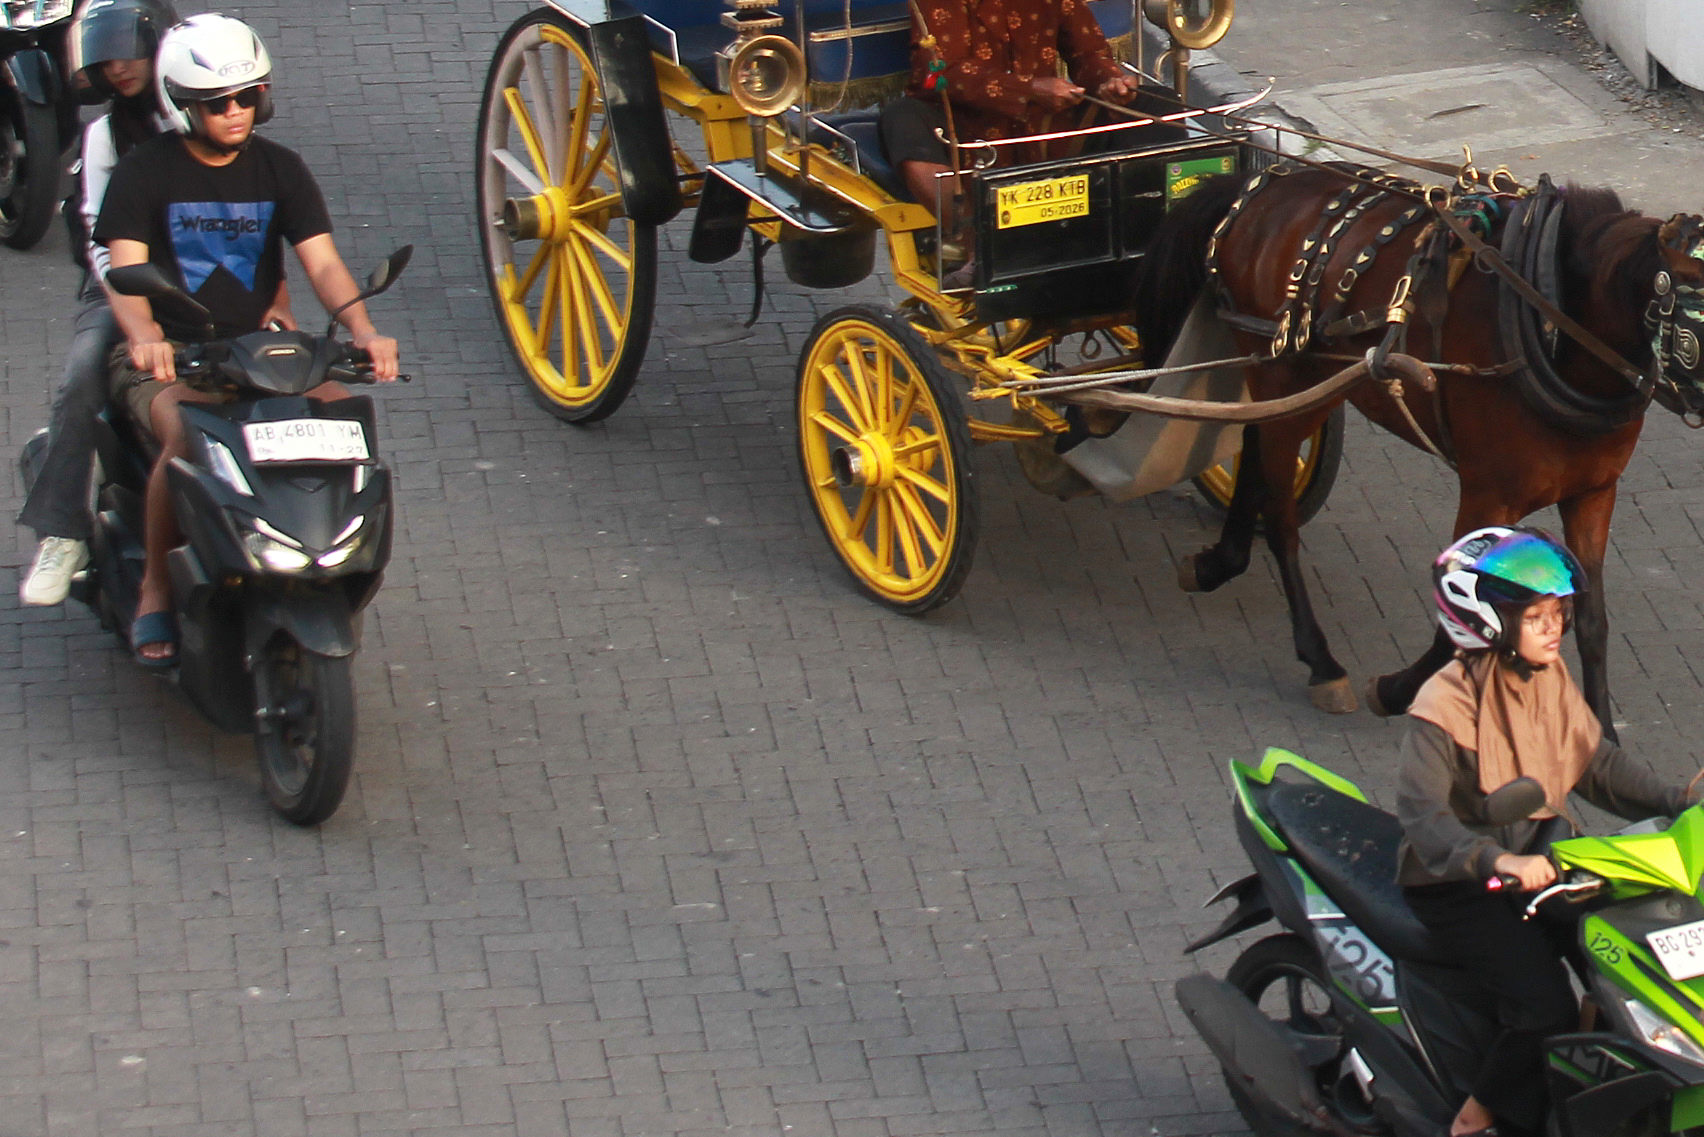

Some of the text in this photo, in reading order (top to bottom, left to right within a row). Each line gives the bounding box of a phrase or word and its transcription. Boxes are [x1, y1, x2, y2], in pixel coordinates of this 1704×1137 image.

[1002, 190, 1019, 206] YK
[1059, 180, 1085, 198] KTB
[180, 215, 264, 241] Wrangler
[254, 426, 275, 441] AB
